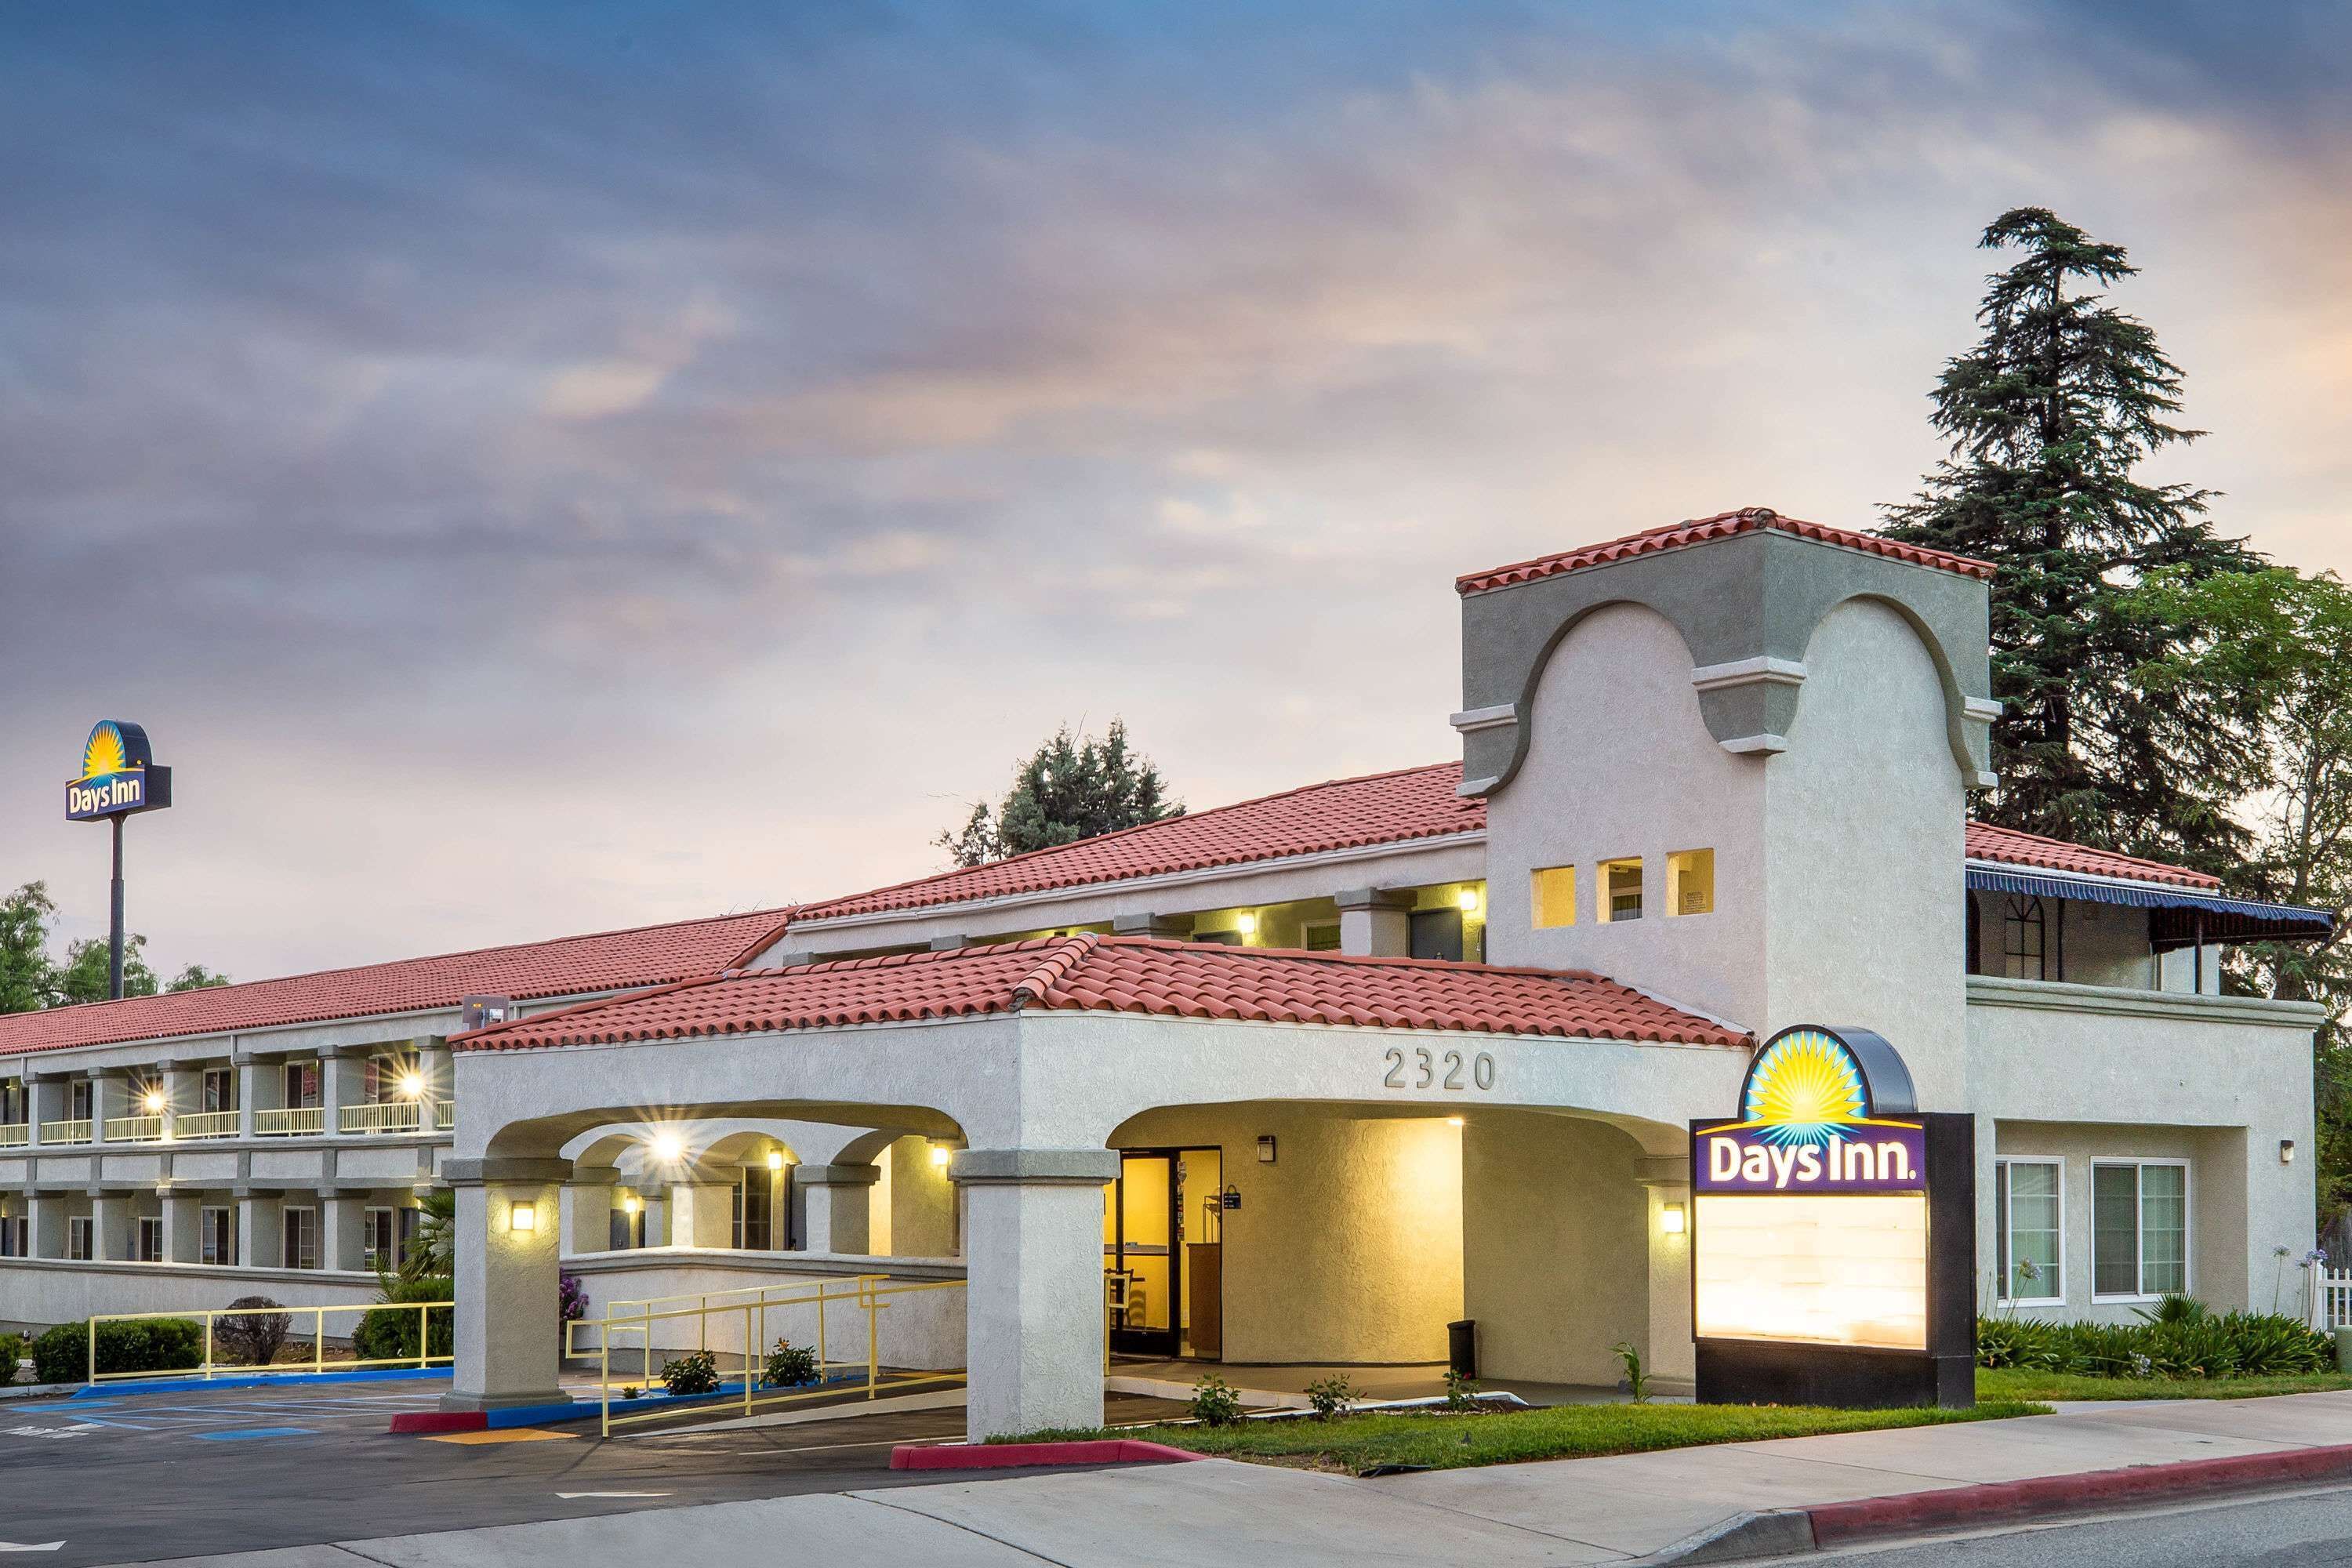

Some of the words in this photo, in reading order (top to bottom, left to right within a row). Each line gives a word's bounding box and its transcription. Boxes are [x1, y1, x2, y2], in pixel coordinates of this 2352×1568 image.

[69, 786, 110, 814] Days
[111, 779, 140, 805] Inn
[1385, 1047, 1495, 1090] 2320
[1710, 1136, 1821, 1189] Days
